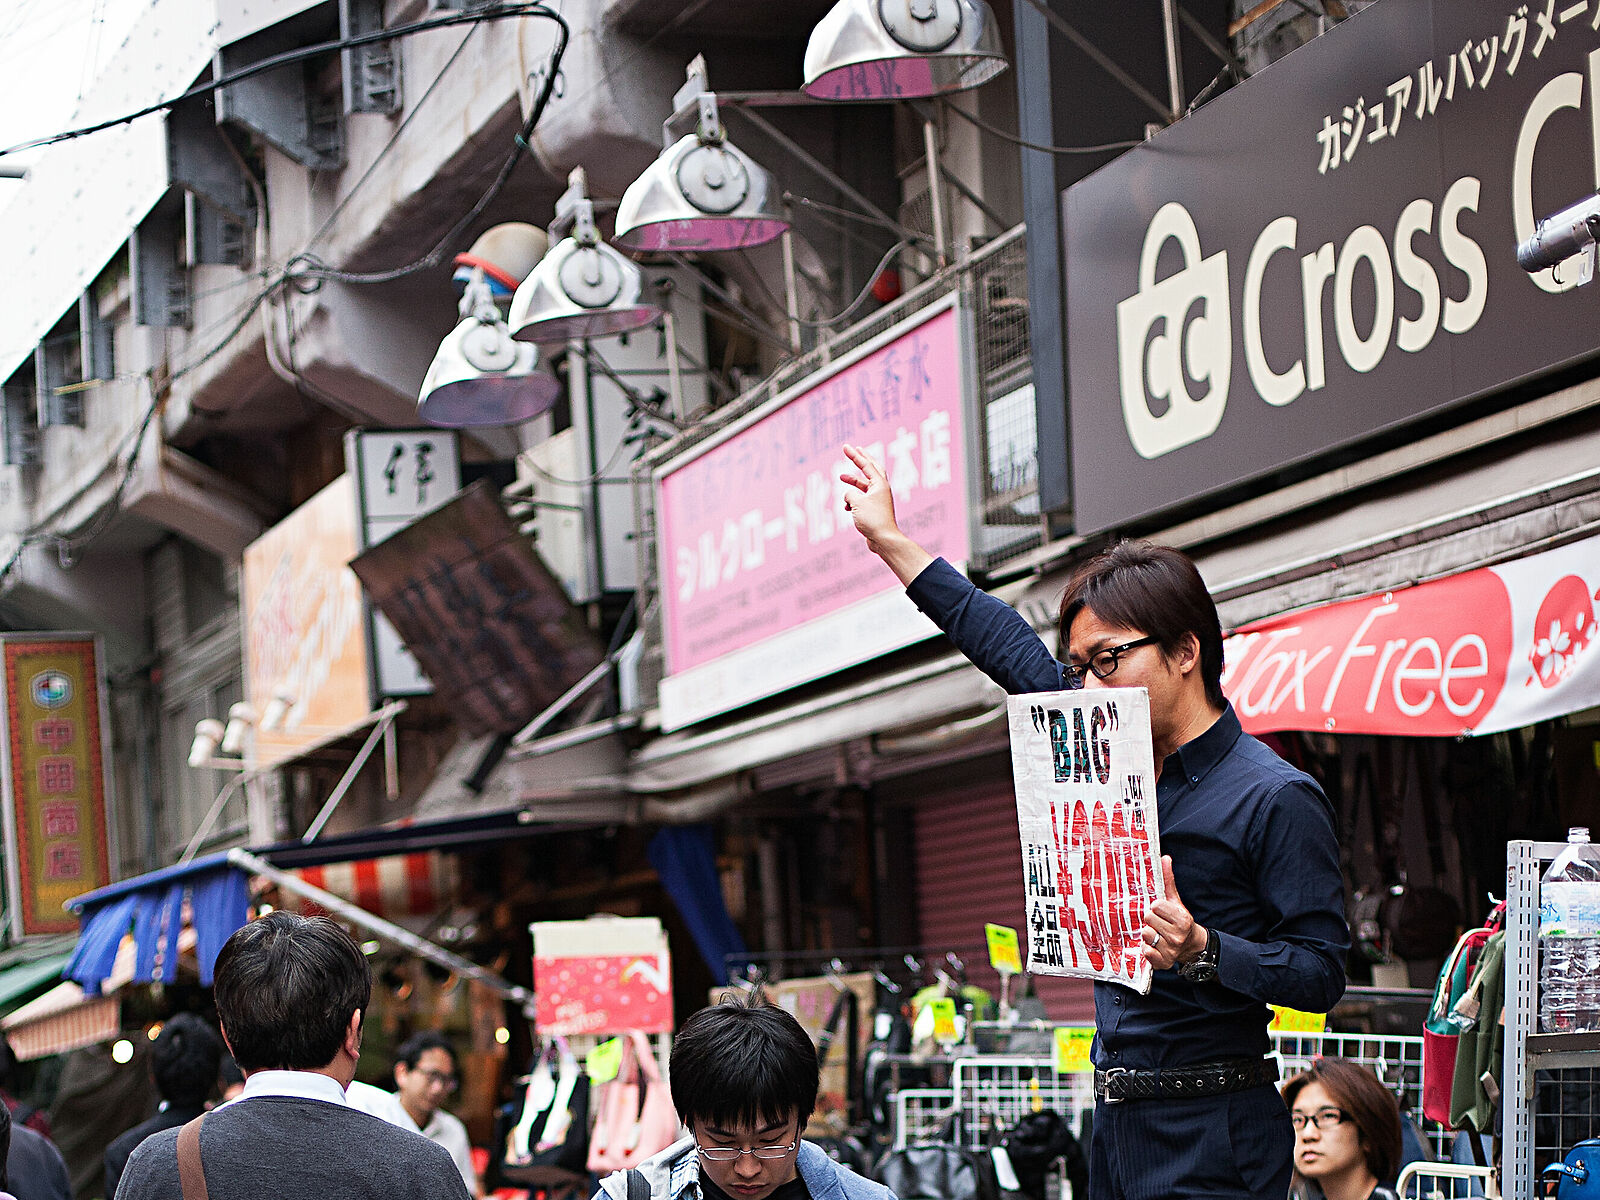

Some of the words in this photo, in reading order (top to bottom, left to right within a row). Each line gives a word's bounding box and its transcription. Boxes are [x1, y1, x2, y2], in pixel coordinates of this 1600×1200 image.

[1243, 176, 1489, 408] Cross
[1512, 49, 1600, 294] C
[1230, 626, 1335, 717] Tax
[1321, 602, 1489, 718] Free
[1028, 843, 1056, 898] ALL
